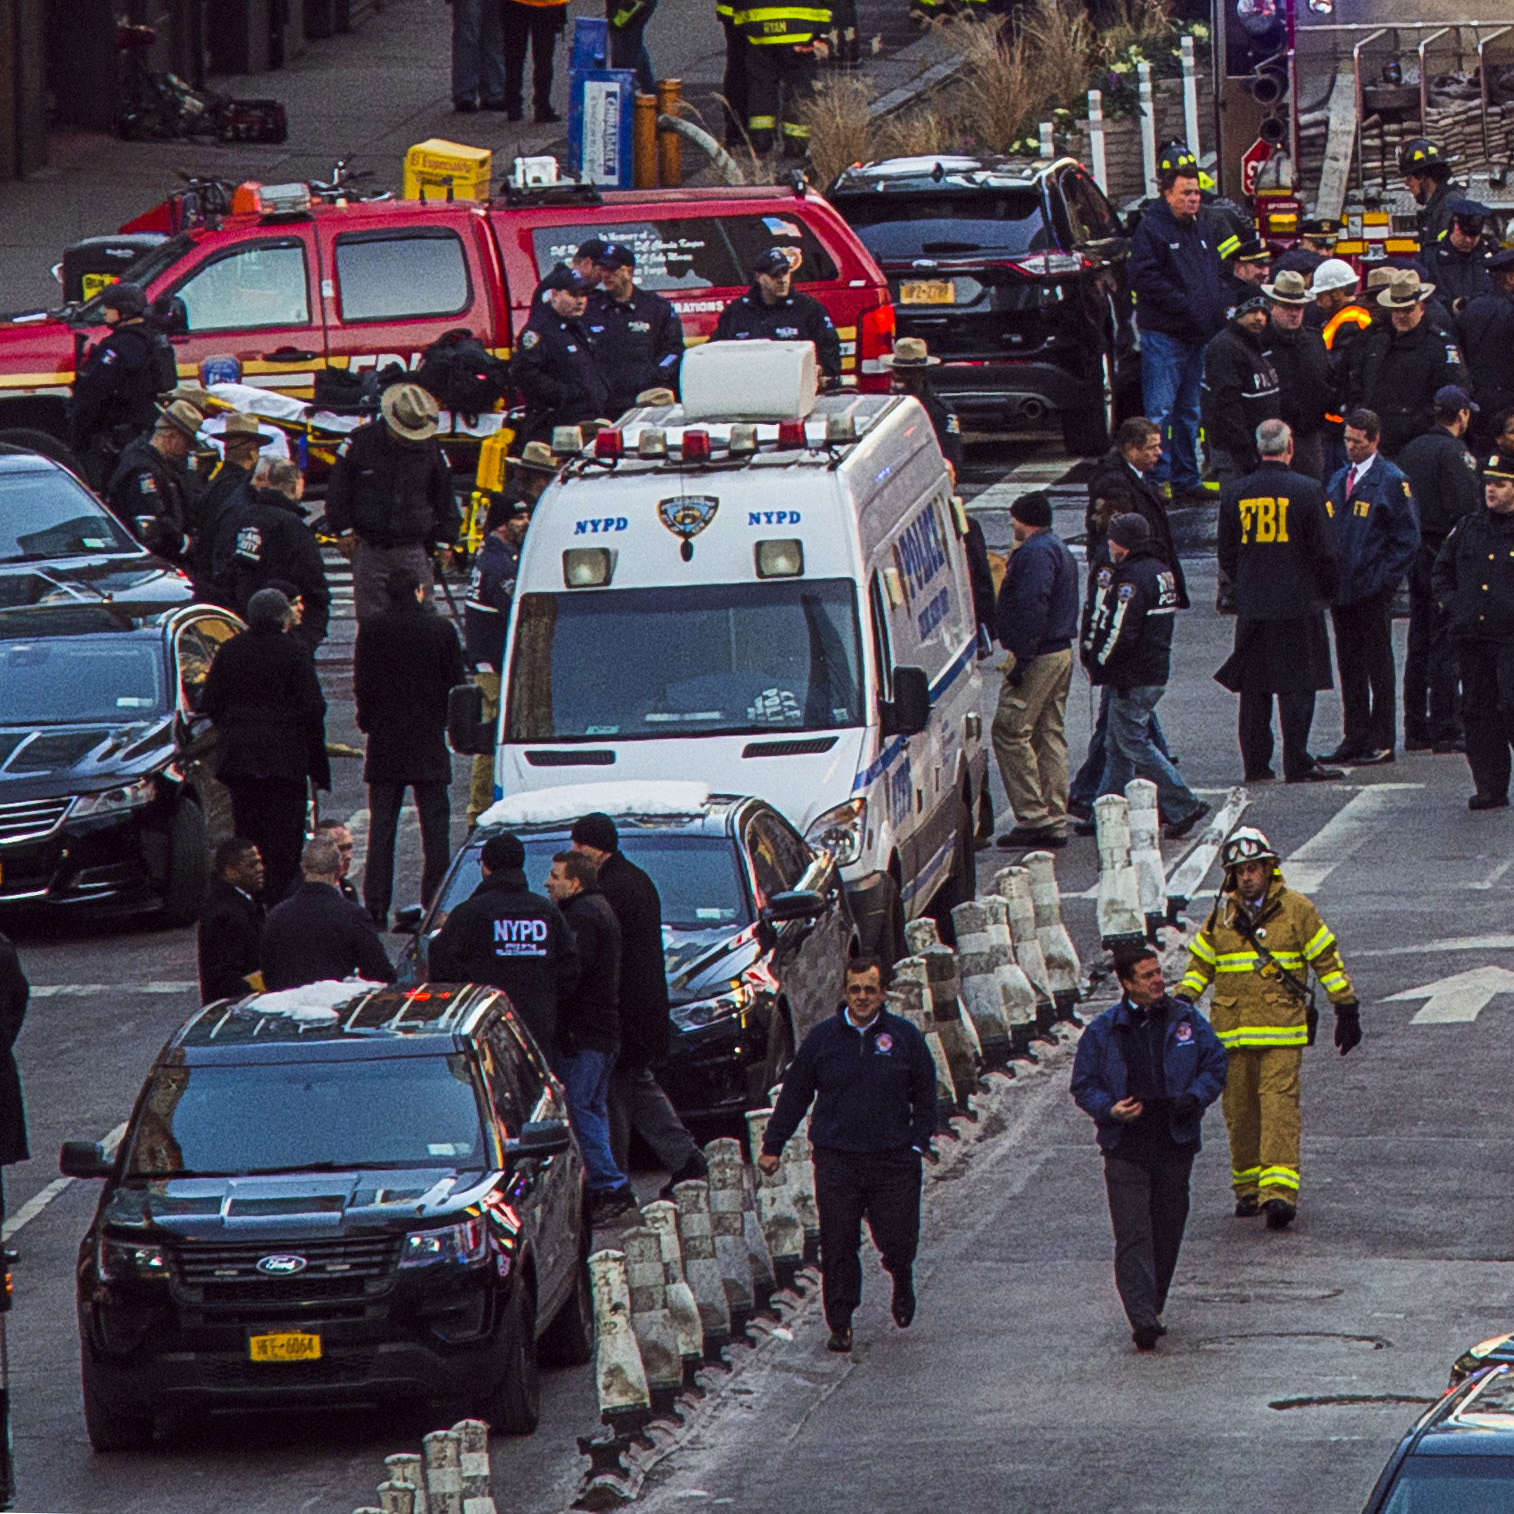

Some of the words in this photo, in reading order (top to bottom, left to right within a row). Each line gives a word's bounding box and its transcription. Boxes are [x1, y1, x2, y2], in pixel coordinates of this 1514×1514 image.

[674, 300, 725, 314] RATIONS
[573, 516, 629, 535] NYPD
[747, 509, 801, 527] NYPD
[1238, 497, 1291, 544] FBI
[493, 919, 548, 942] NYPD
